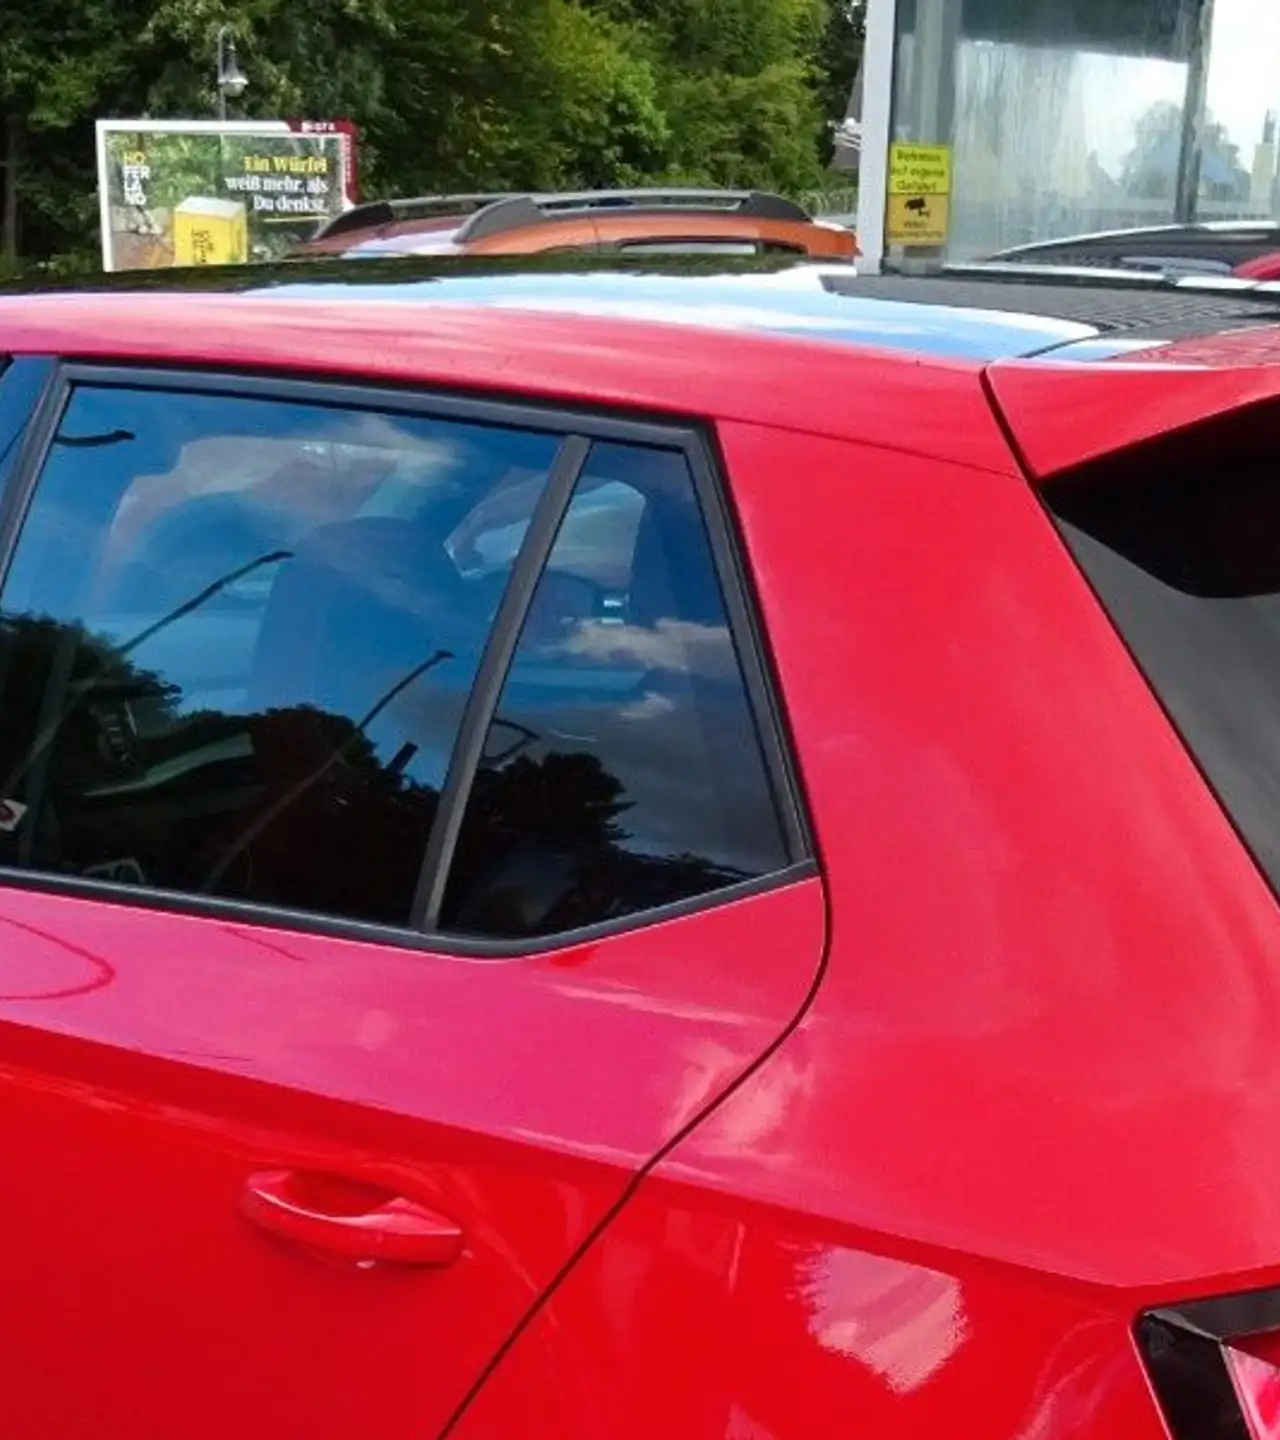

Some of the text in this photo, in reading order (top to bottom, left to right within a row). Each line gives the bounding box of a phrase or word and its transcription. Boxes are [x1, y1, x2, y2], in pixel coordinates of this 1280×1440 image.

[244, 155, 328, 172] Ein Würfel
[224, 174, 260, 191] weiß
[253, 195, 274, 211] Du
